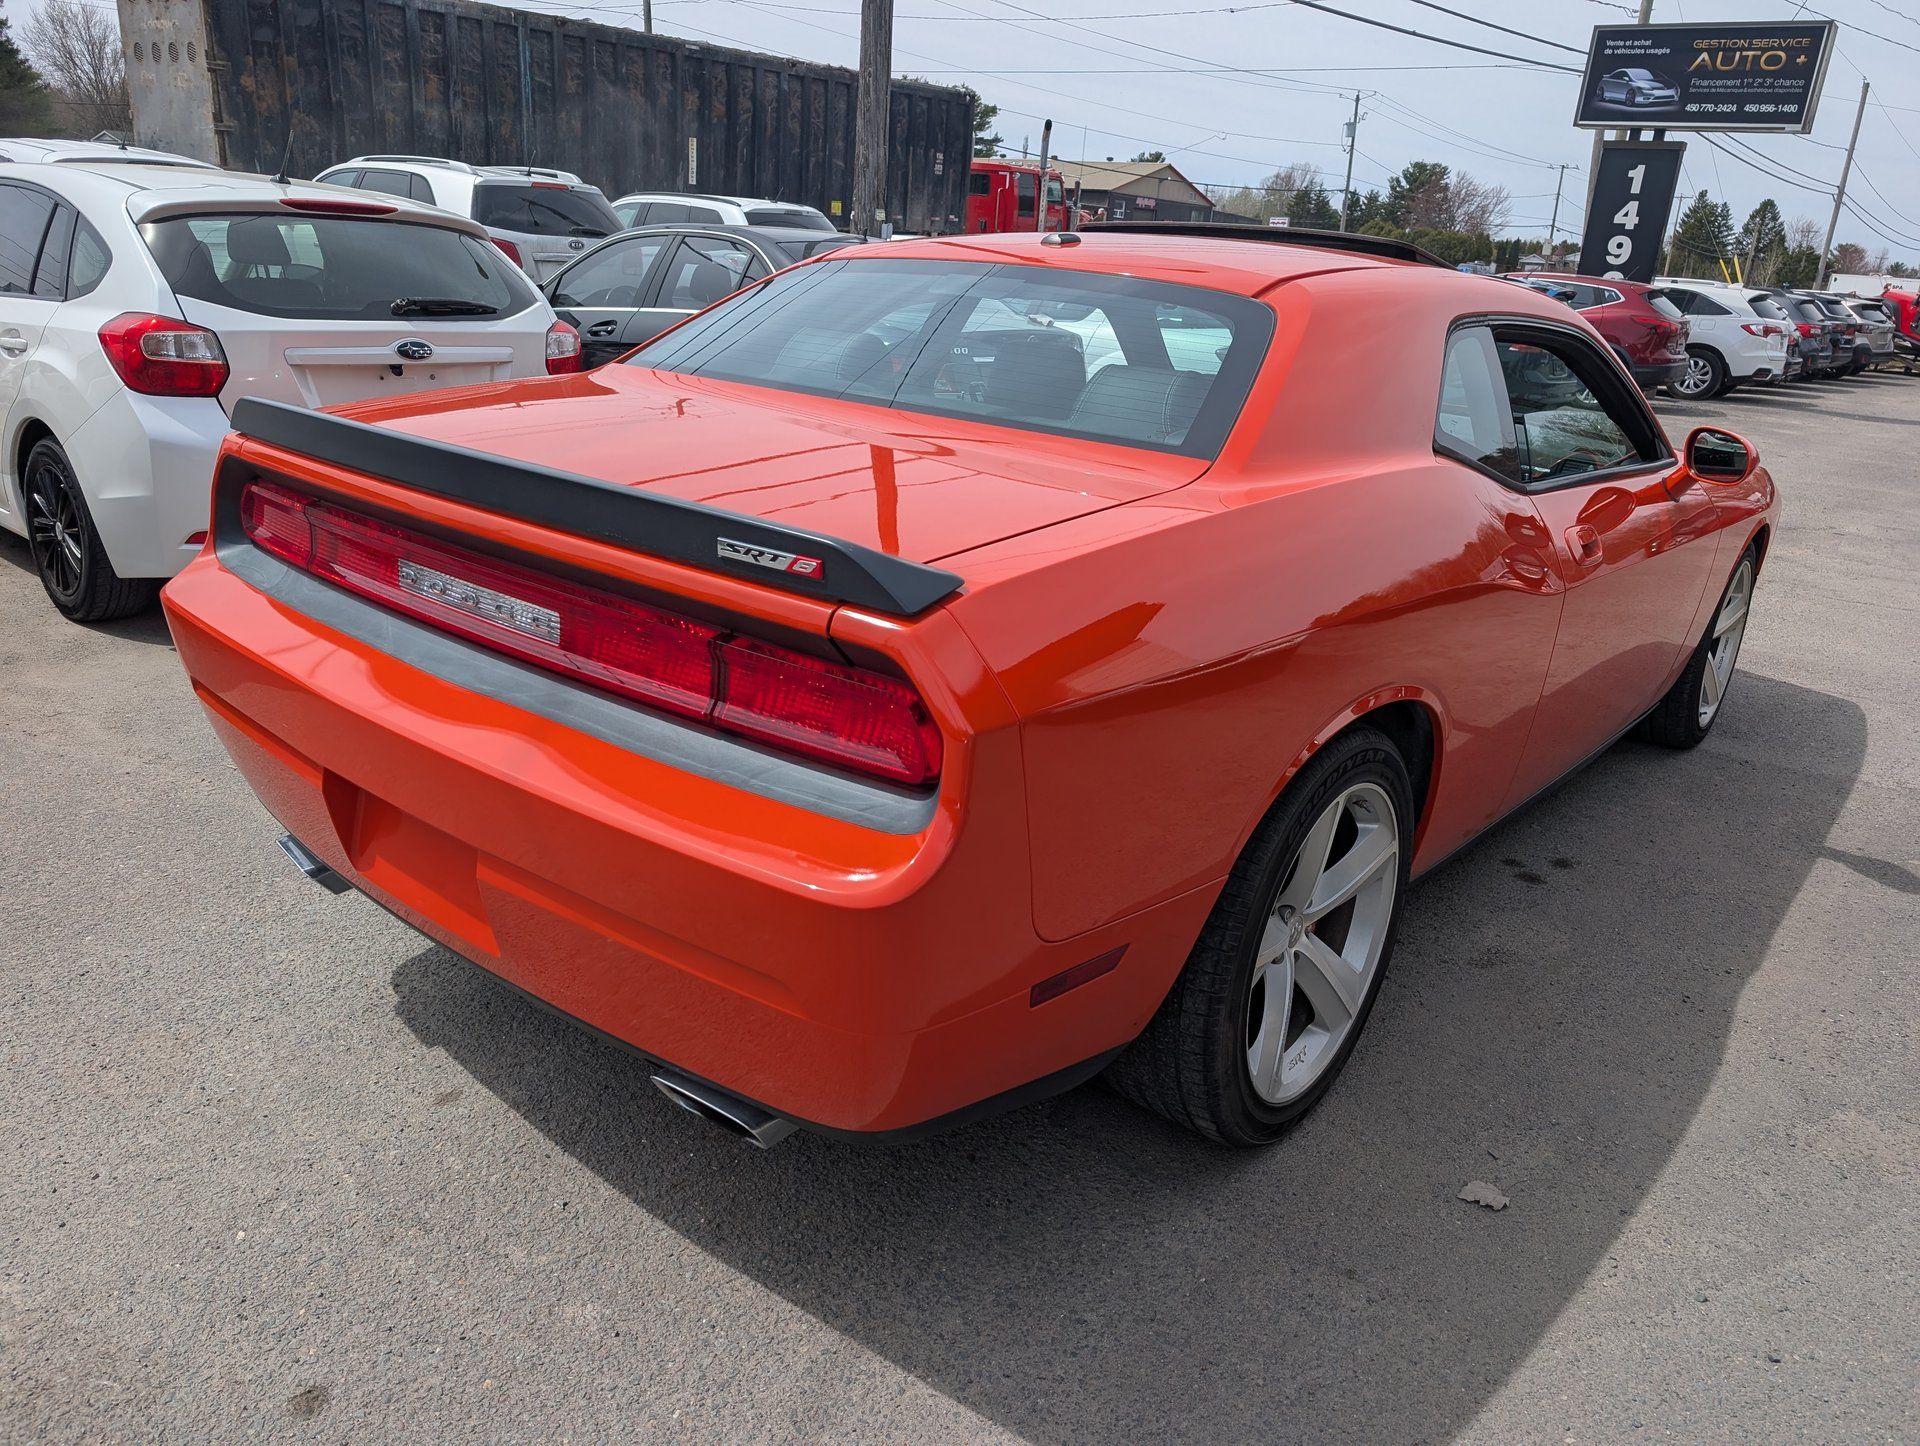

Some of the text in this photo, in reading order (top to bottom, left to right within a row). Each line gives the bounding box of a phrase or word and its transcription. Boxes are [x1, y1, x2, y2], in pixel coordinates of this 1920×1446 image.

[1693, 38, 1811, 49] GESTION SERVICE
[1614, 47, 1645, 55] véhicules
[1646, 47, 1671, 55] usagés
[1687, 50, 1787, 72] AUTO
[1690, 77, 1741, 87] Financement
[1774, 77, 1805, 86] chance
[1685, 103, 1737, 112] 450 770-2424
[1744, 103, 1798, 113] 450 956-1400
[1602, 164, 1646, 280] 149
[1288, 1044, 1307, 1071] SRT
